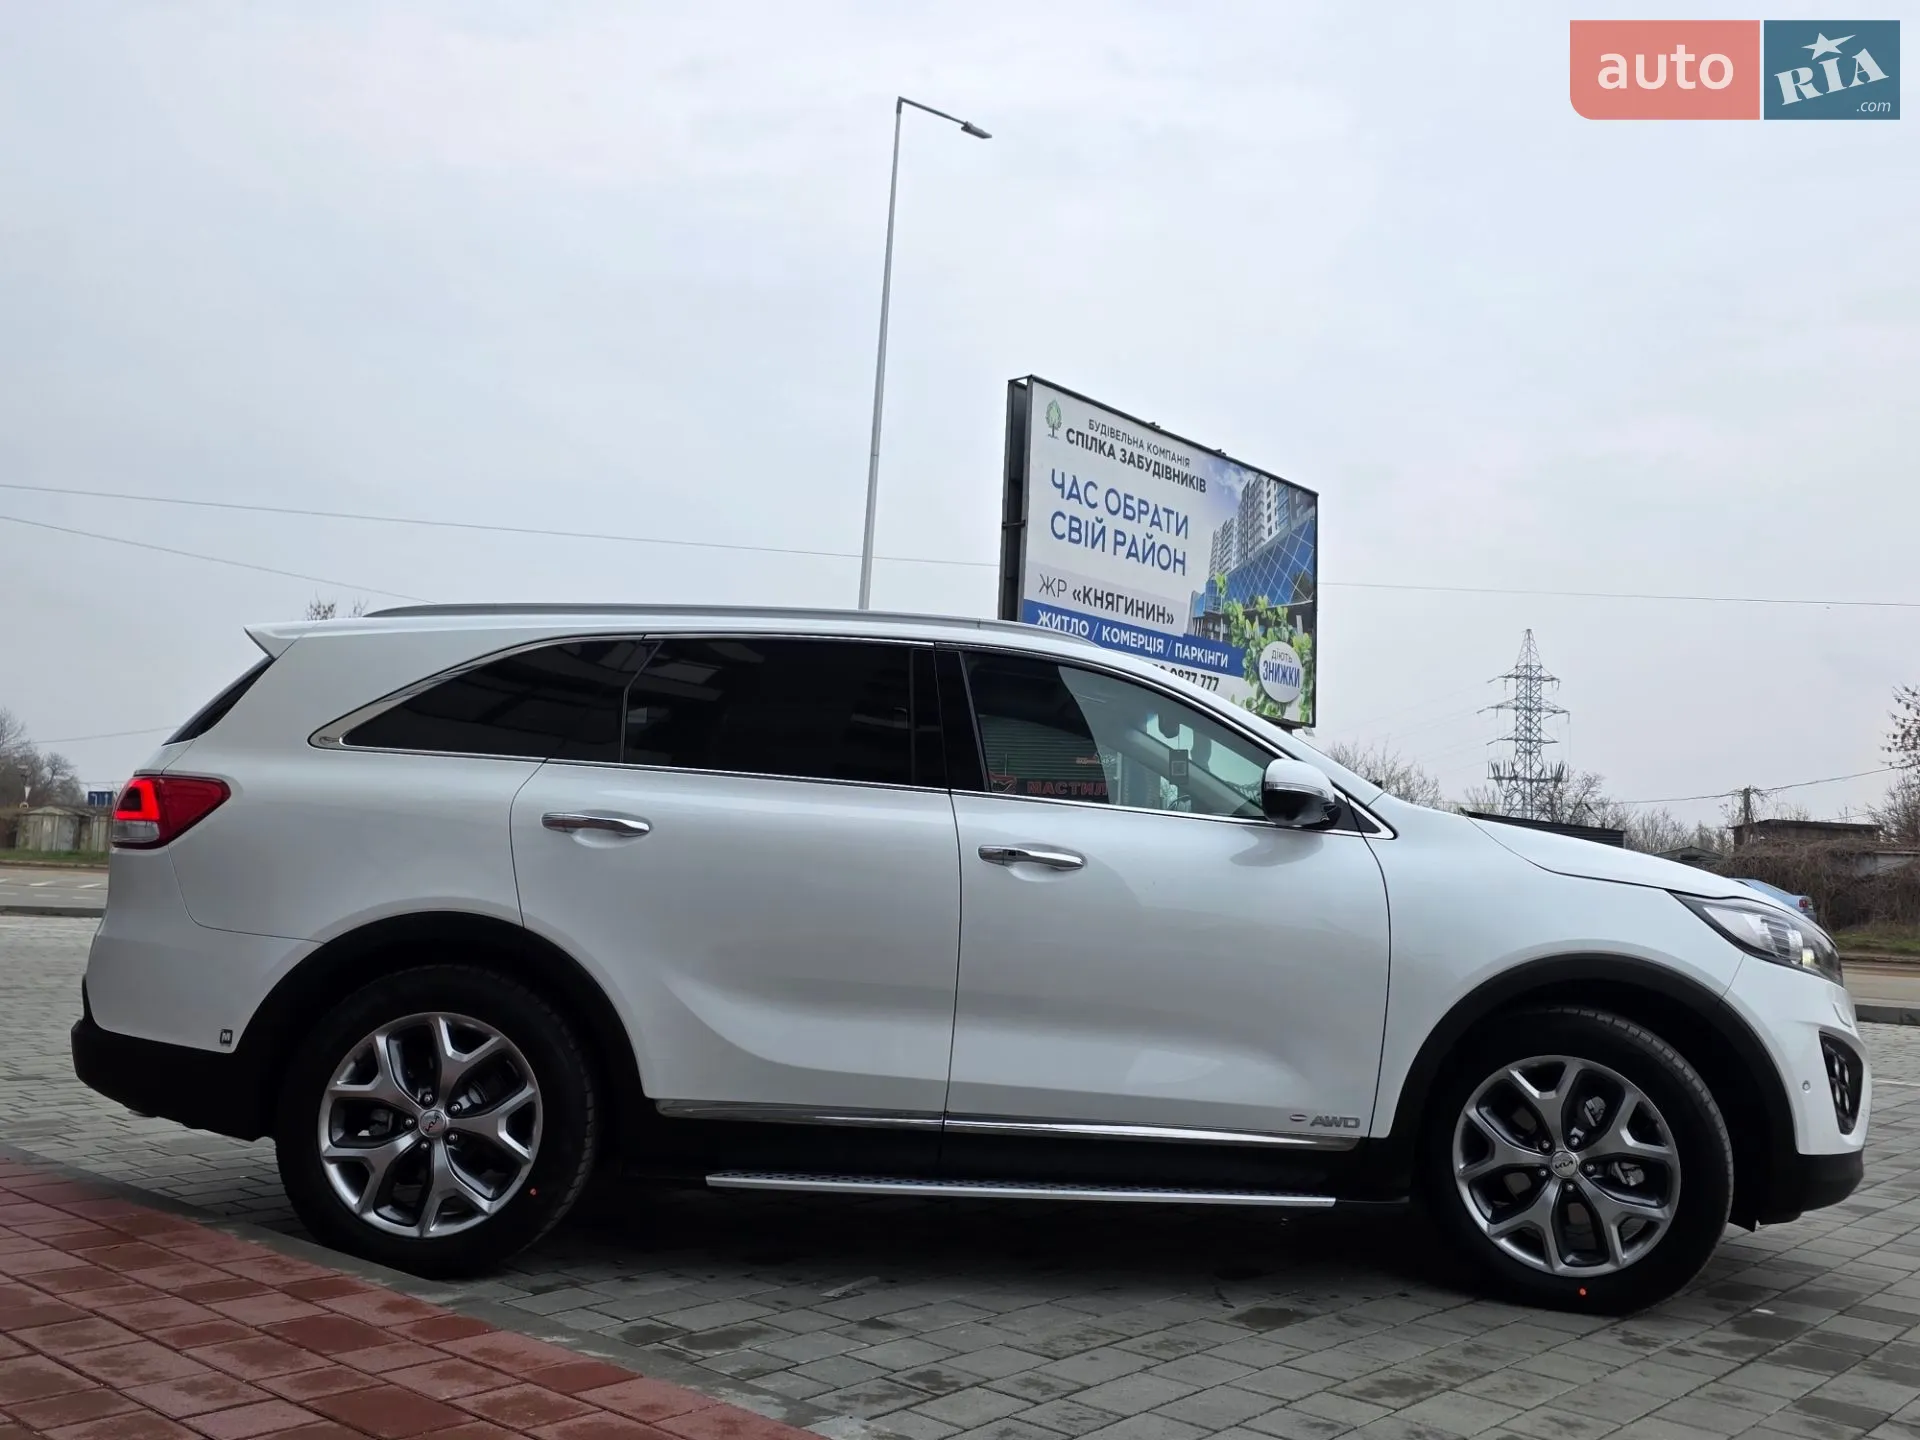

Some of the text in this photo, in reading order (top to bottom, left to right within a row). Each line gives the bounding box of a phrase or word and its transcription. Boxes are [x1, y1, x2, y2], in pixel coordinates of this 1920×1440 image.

[1066, 427, 1207, 493] СПІЛКА ЗАБУДІВНИКІВ
[1088, 418, 1190, 468] БУДІВЕЛЬНА КОМПАНІЯ
[1051, 468, 1189, 540] ЧАС ОБРАТИ
[1050, 510, 1186, 576] СВІЙ РАЙОН
[1038, 573, 1175, 625] ЖР «КНЯГИНИН»
[1036, 610, 1089, 637] ЖИТЛО
[1102, 625, 1164, 653] КОМЕРЦІЯ
[1175, 642, 1229, 668] ПАРКІНГИ
[1200, 673, 1220, 692] 777
[1262, 660, 1300, 688] ЗНИЖКИ
[1310, 1115, 1360, 1128] AWD
